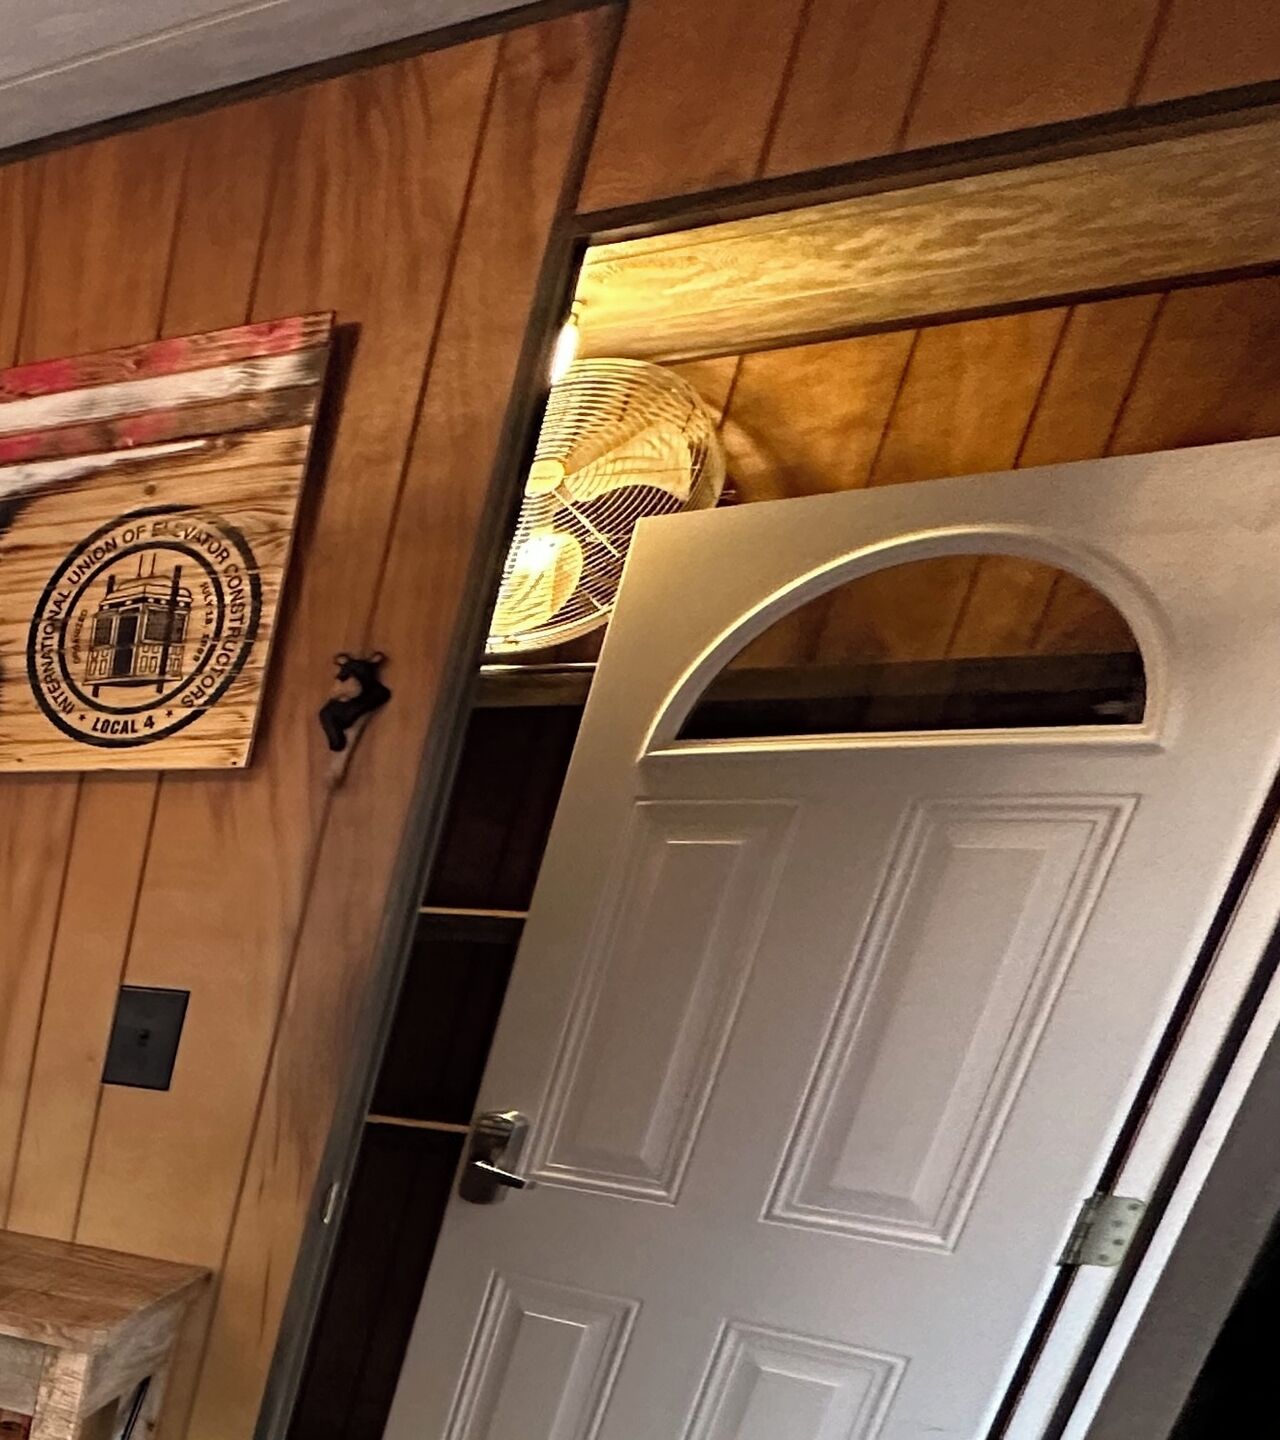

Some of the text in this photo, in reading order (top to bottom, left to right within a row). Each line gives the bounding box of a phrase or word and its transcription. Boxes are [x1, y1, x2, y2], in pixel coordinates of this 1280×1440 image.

[40, 589, 76, 715] INTERNATIONAL
[67, 538, 118, 585] UNION
[122, 527, 146, 544] OF
[181, 563, 246, 708] CONSTRUCTORS
[91, 715, 155, 735] LOCAL 4
